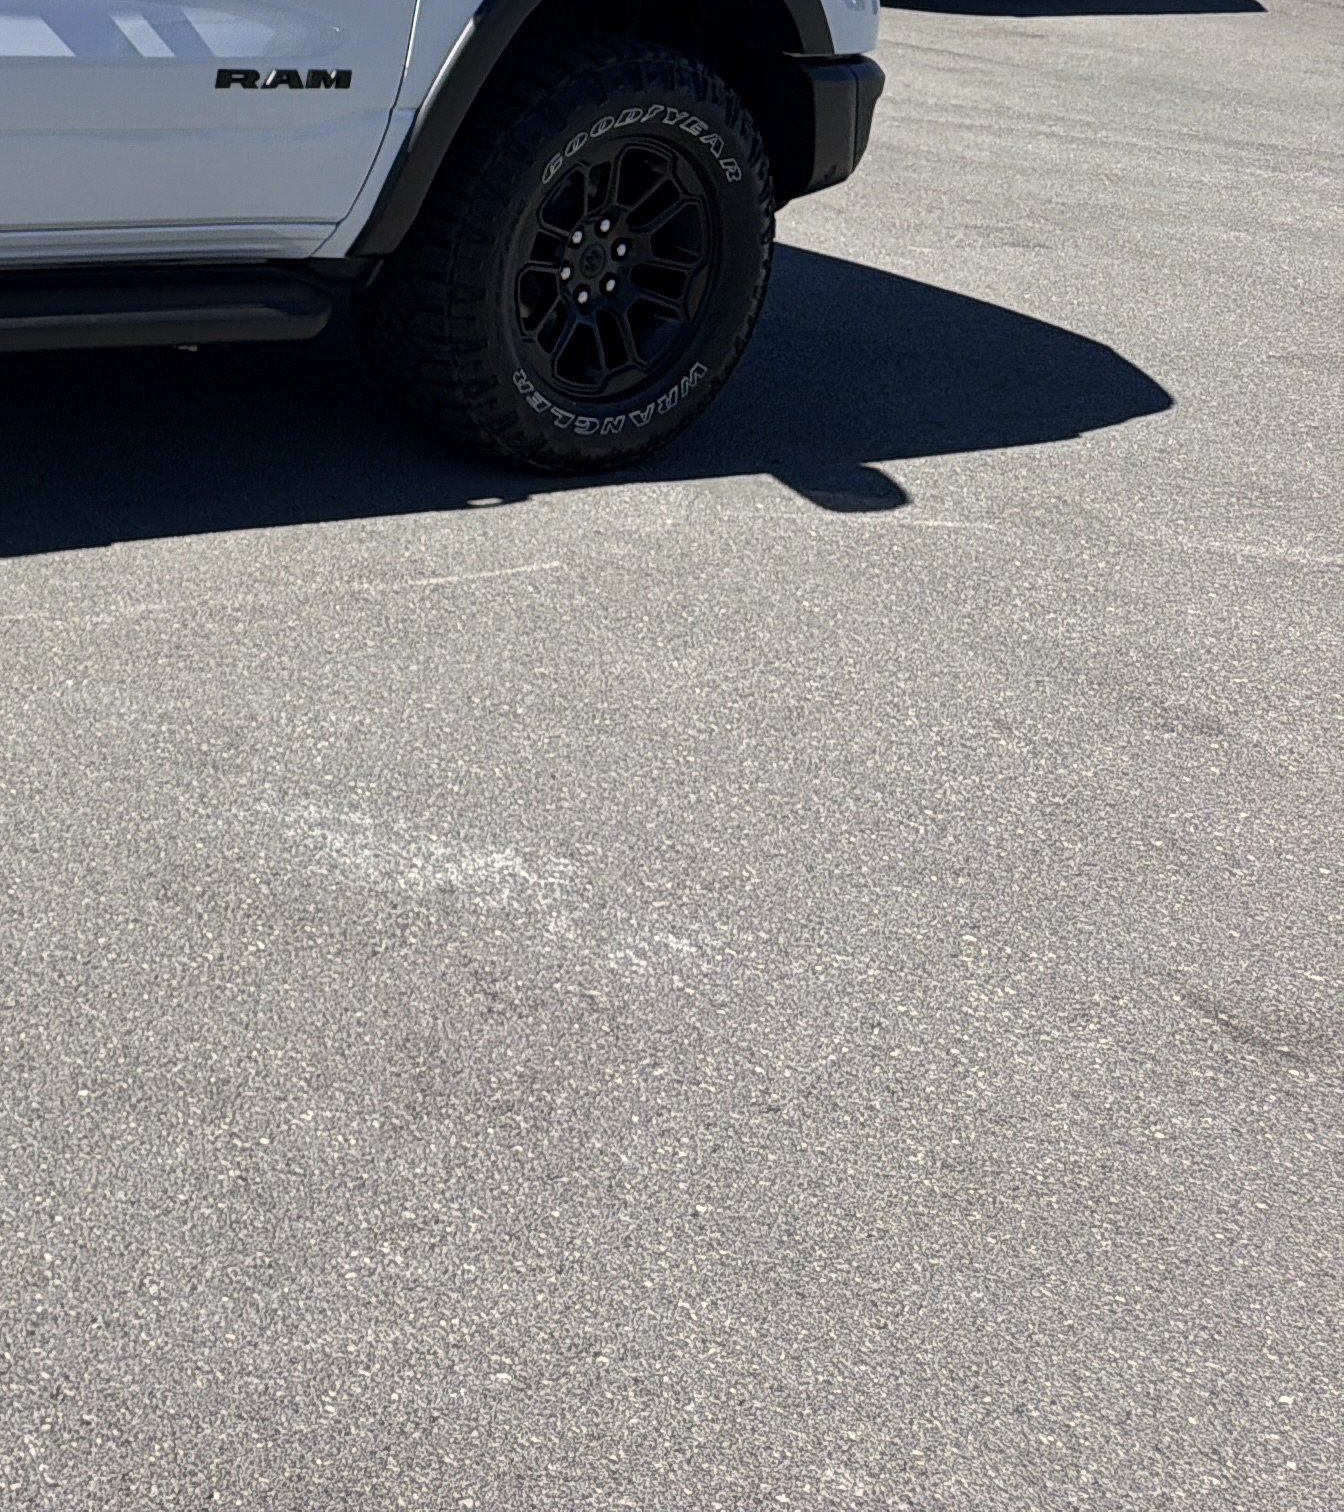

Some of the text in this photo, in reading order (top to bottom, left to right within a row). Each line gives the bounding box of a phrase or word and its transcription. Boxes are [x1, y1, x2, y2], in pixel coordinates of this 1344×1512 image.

[215, 68, 353, 90] RAM
[542, 104, 742, 184] GOODYEAR
[513, 362, 708, 436] WRANGLER
